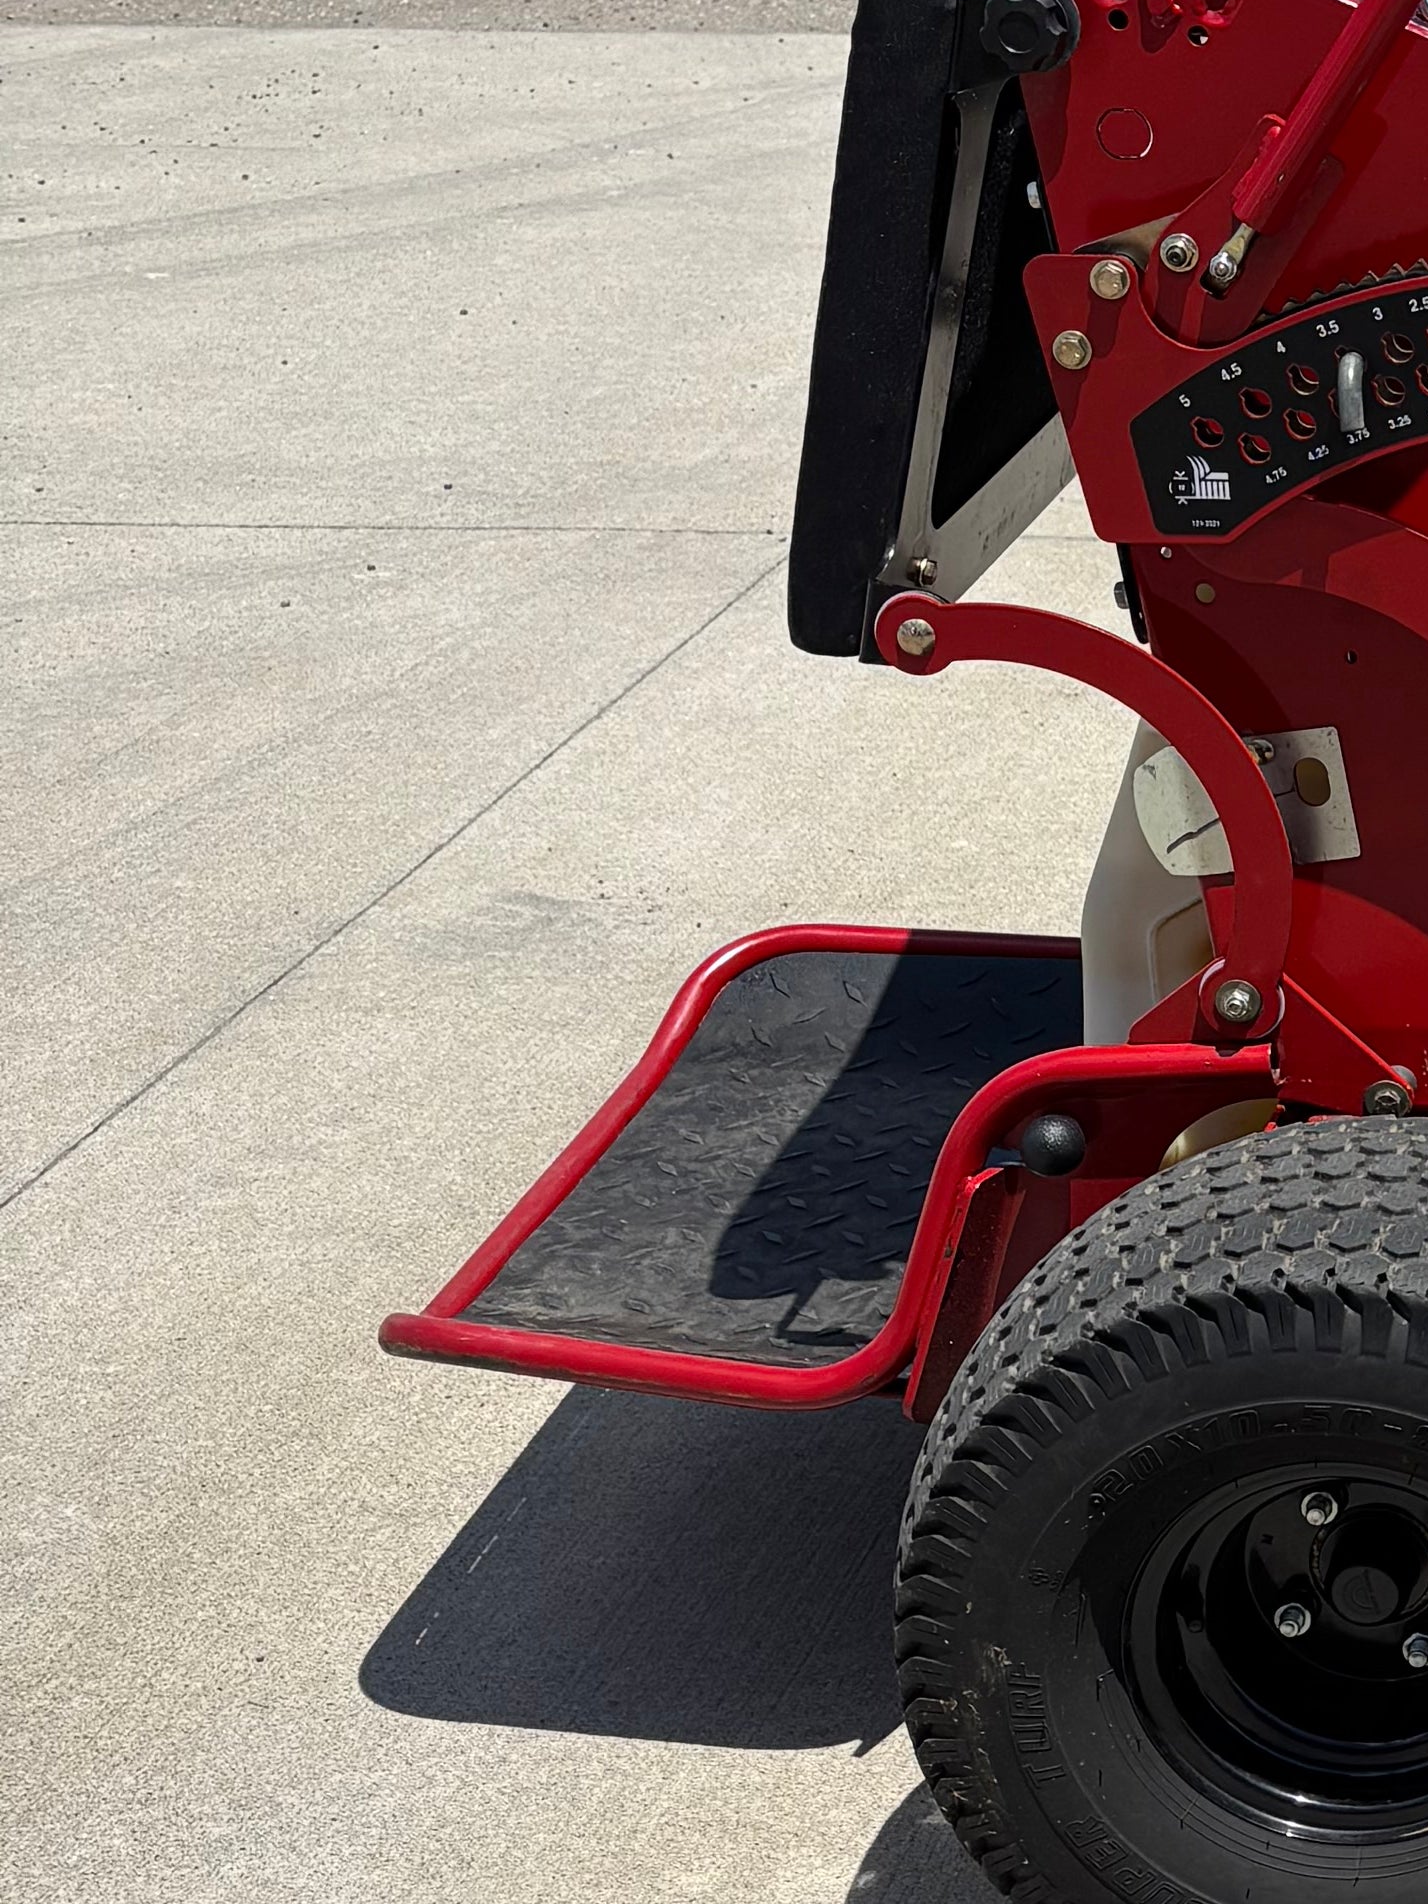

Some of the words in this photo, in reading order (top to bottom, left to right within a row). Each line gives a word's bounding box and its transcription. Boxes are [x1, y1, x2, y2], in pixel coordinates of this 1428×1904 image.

[1179, 393, 1193, 409] 5
[1219, 362, 1243, 383] 4.5
[1275, 339, 1287, 355] 4
[1315, 319, 1341, 339] 3.5
[1371, 306, 1384, 321] 3
[1264, 466, 1288, 486] 4.75
[1346, 427, 1372, 447] 3.75
[1387, 413, 1413, 431] 3.25
[1007, 1667, 1067, 1790] TURF
